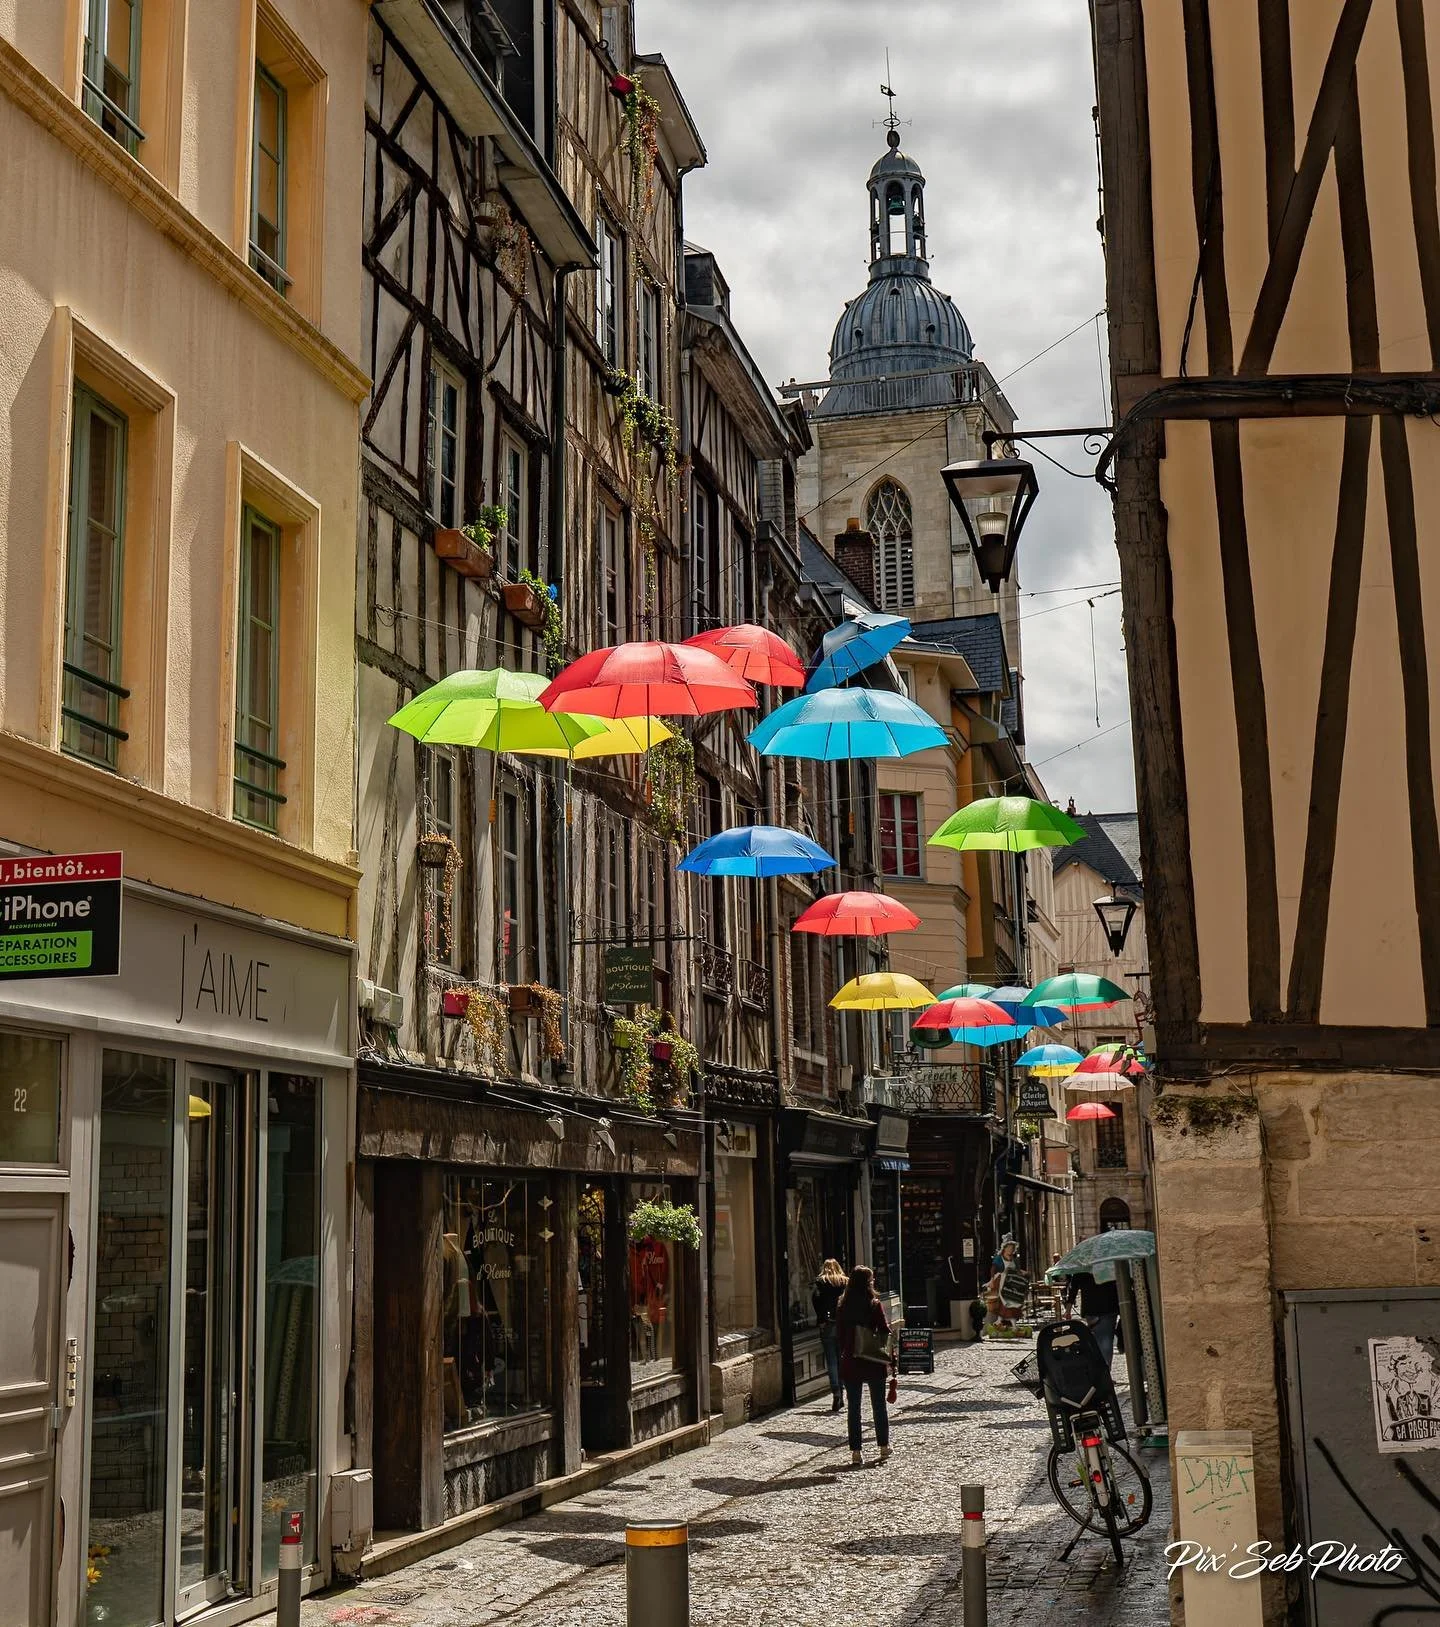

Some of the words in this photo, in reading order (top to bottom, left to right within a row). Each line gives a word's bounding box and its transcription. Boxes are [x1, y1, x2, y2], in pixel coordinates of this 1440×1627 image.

[175, 923, 271, 1024] J'AIME
[606, 964, 650, 974] BOUTIQUE
[13, 1087, 28, 1113] 22
[472, 1227, 516, 1249] BOUTIQUE
